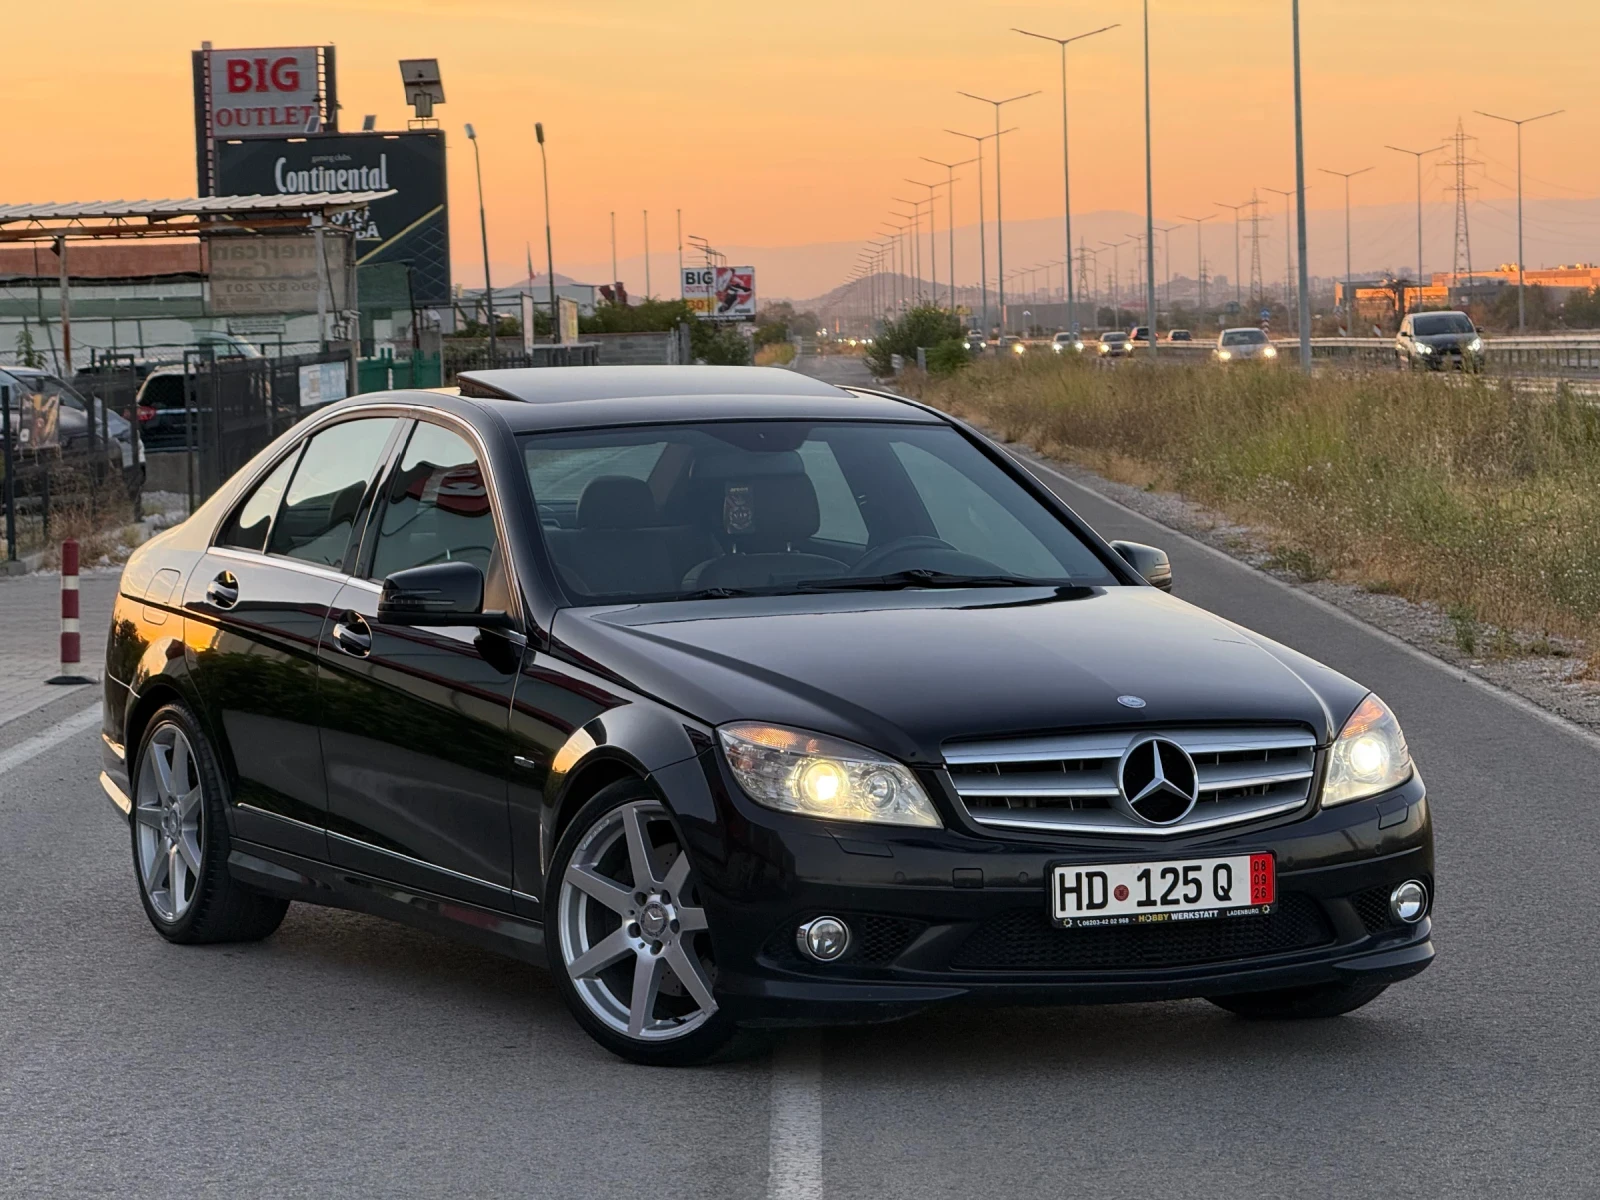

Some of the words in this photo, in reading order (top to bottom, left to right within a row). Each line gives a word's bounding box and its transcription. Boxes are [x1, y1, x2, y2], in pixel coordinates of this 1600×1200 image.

[226, 57, 300, 93] BIG
[216, 105, 314, 127] OUTLET
[275, 153, 389, 193] Continental
[685, 271, 713, 285] BIG
[1253, 860, 1266, 871] 08
[1254, 874, 1267, 885] 09
[1059, 870, 1109, 912] HD
[1136, 865, 1203, 907] 125
[1213, 863, 1232, 902] Q
[1254, 887, 1267, 899] 26
[1170, 910, 1219, 920] WERKSTATT
[1226, 908, 1260, 917] LADENBURG
